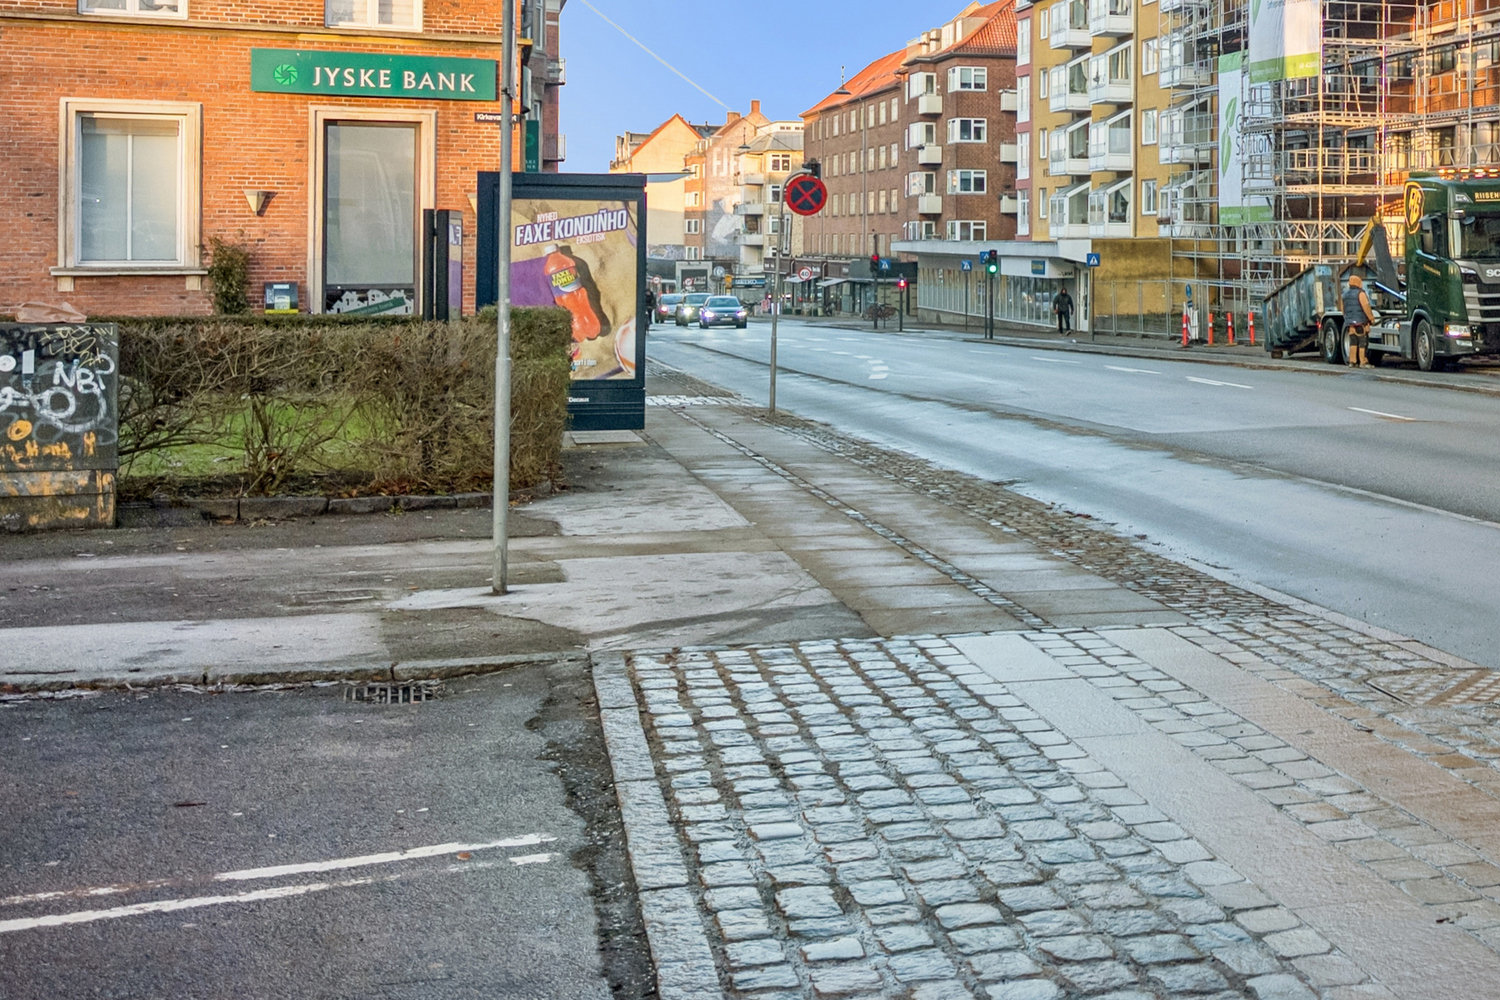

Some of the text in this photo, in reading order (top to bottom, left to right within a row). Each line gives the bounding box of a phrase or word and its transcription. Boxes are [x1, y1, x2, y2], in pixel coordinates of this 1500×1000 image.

[312, 66, 475, 92] JYSKE BANK
[515, 209, 627, 246] FAXE KONDIÑHO
